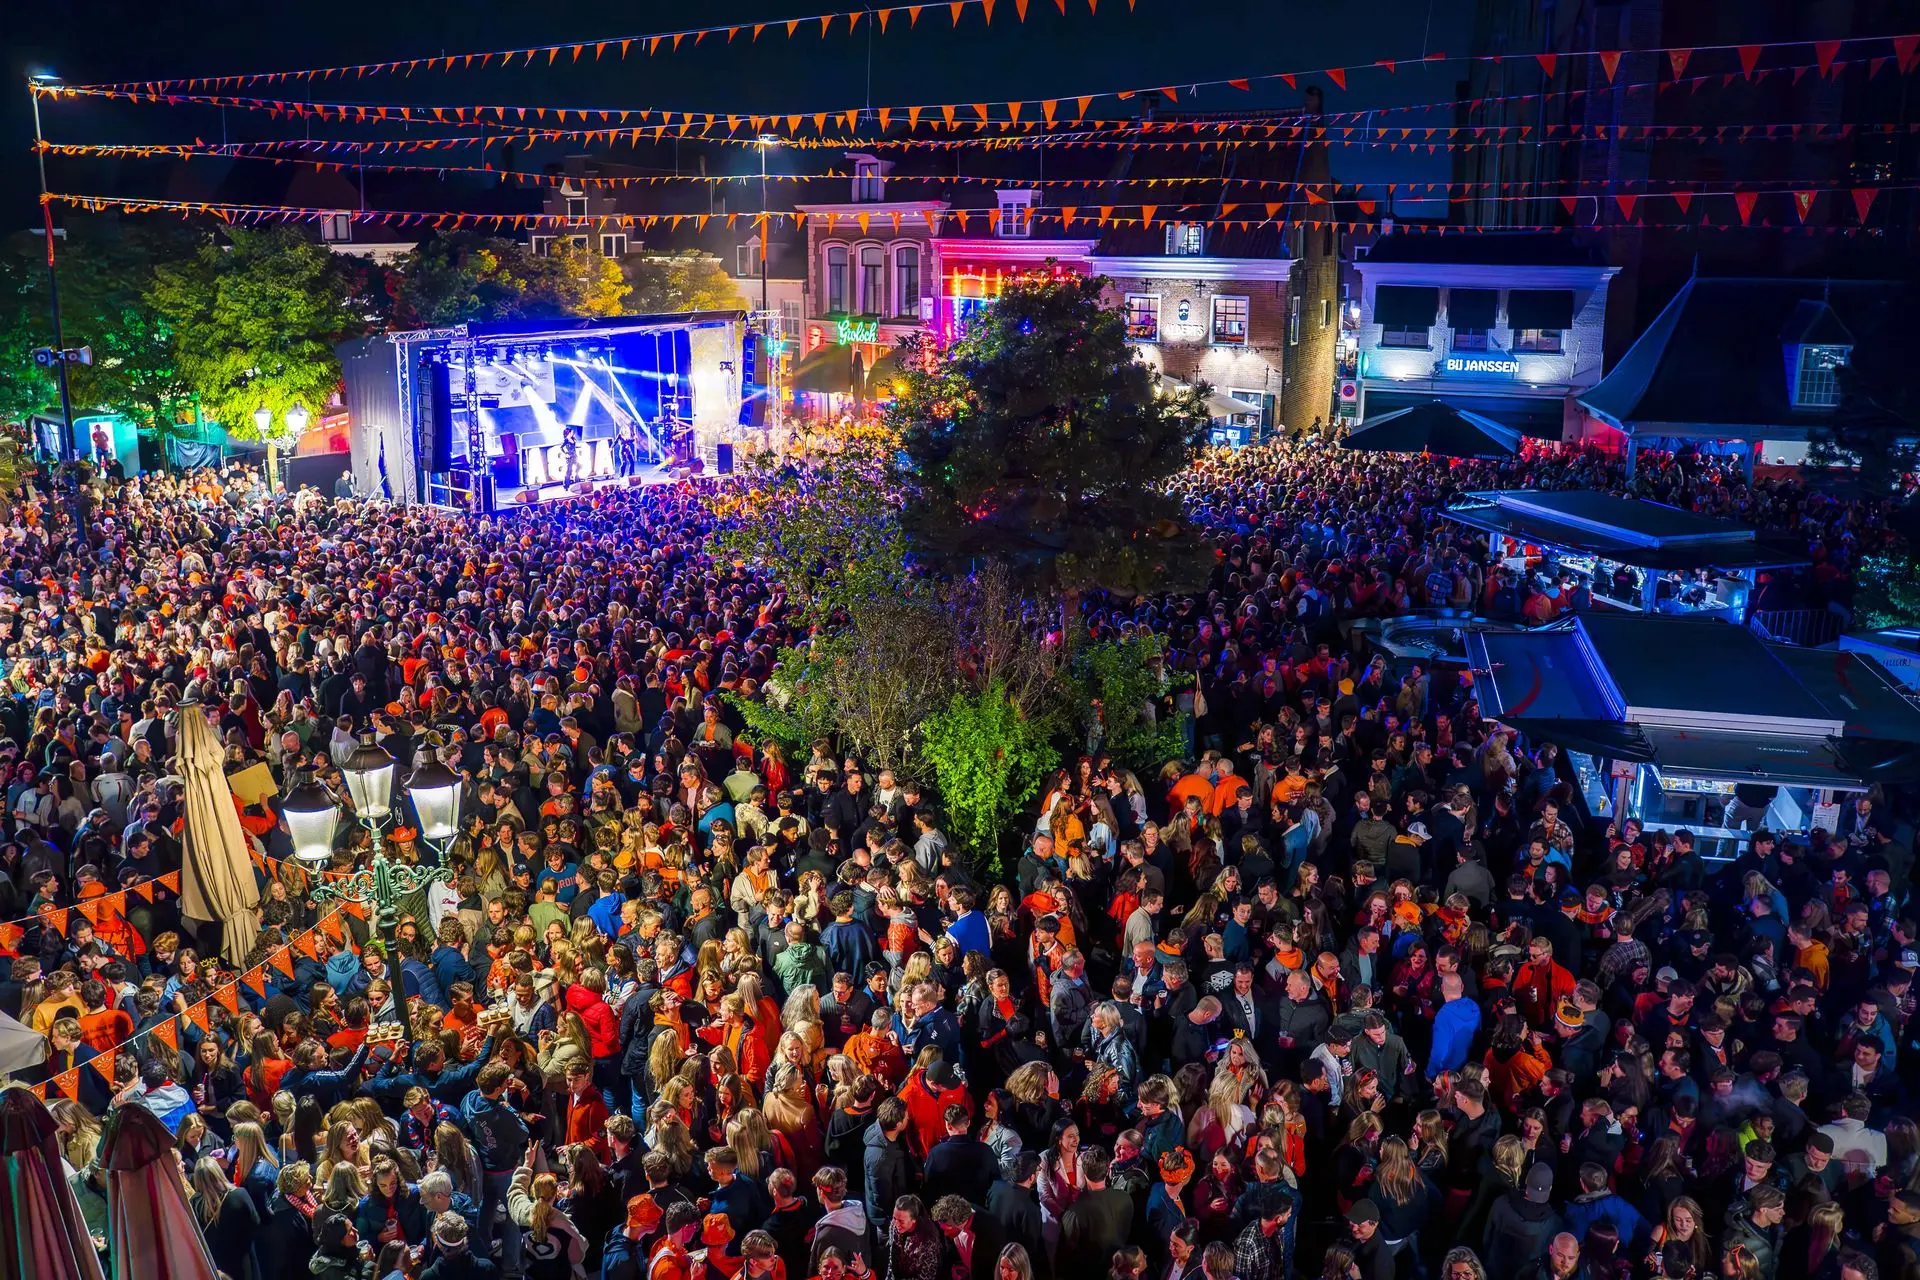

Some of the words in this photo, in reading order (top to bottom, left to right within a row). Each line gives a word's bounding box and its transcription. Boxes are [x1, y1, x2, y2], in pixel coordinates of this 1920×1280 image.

[838, 320, 877, 345] Grolsch
[1447, 359, 1463, 371] BIJ
[1464, 360, 1519, 373] JANSSEN
